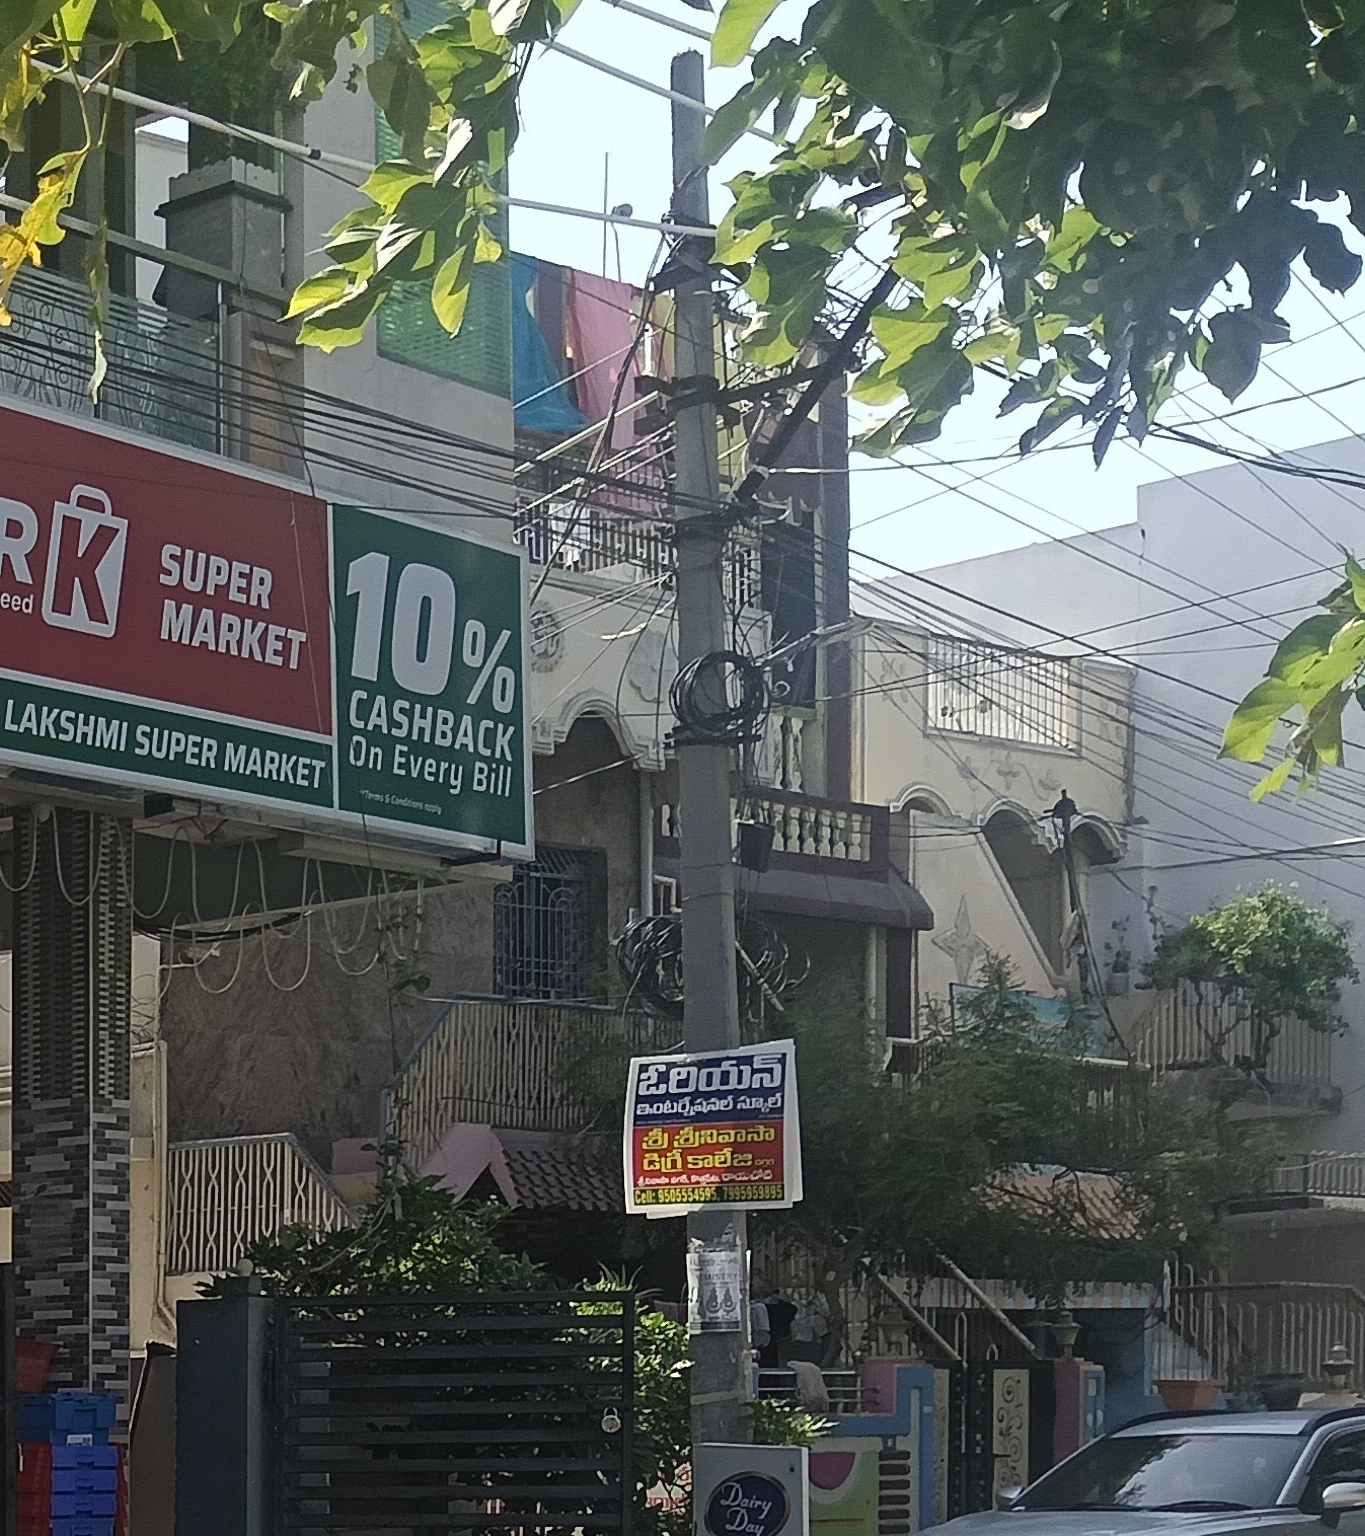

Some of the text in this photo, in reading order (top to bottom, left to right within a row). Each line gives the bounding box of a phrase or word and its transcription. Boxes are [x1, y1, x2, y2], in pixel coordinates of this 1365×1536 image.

[160, 544, 272, 609] SUPER
[160, 599, 307, 670] MARKET
[346, 552, 516, 714] 10%
[4, 699, 128, 751] LAKSHMI
[134, 724, 218, 769] SUPER
[224, 742, 326, 789] MARKET
[349, 690, 516, 762] CASHBACK
[349, 735, 512, 797] On Every Bill
[642, 1128, 668, 1150] శ్రీ
[643, 1148, 682, 1172] డిగ్రీ
[634, 1190, 655, 1204] Cell:
[720, 1482, 772, 1519] Dairy
